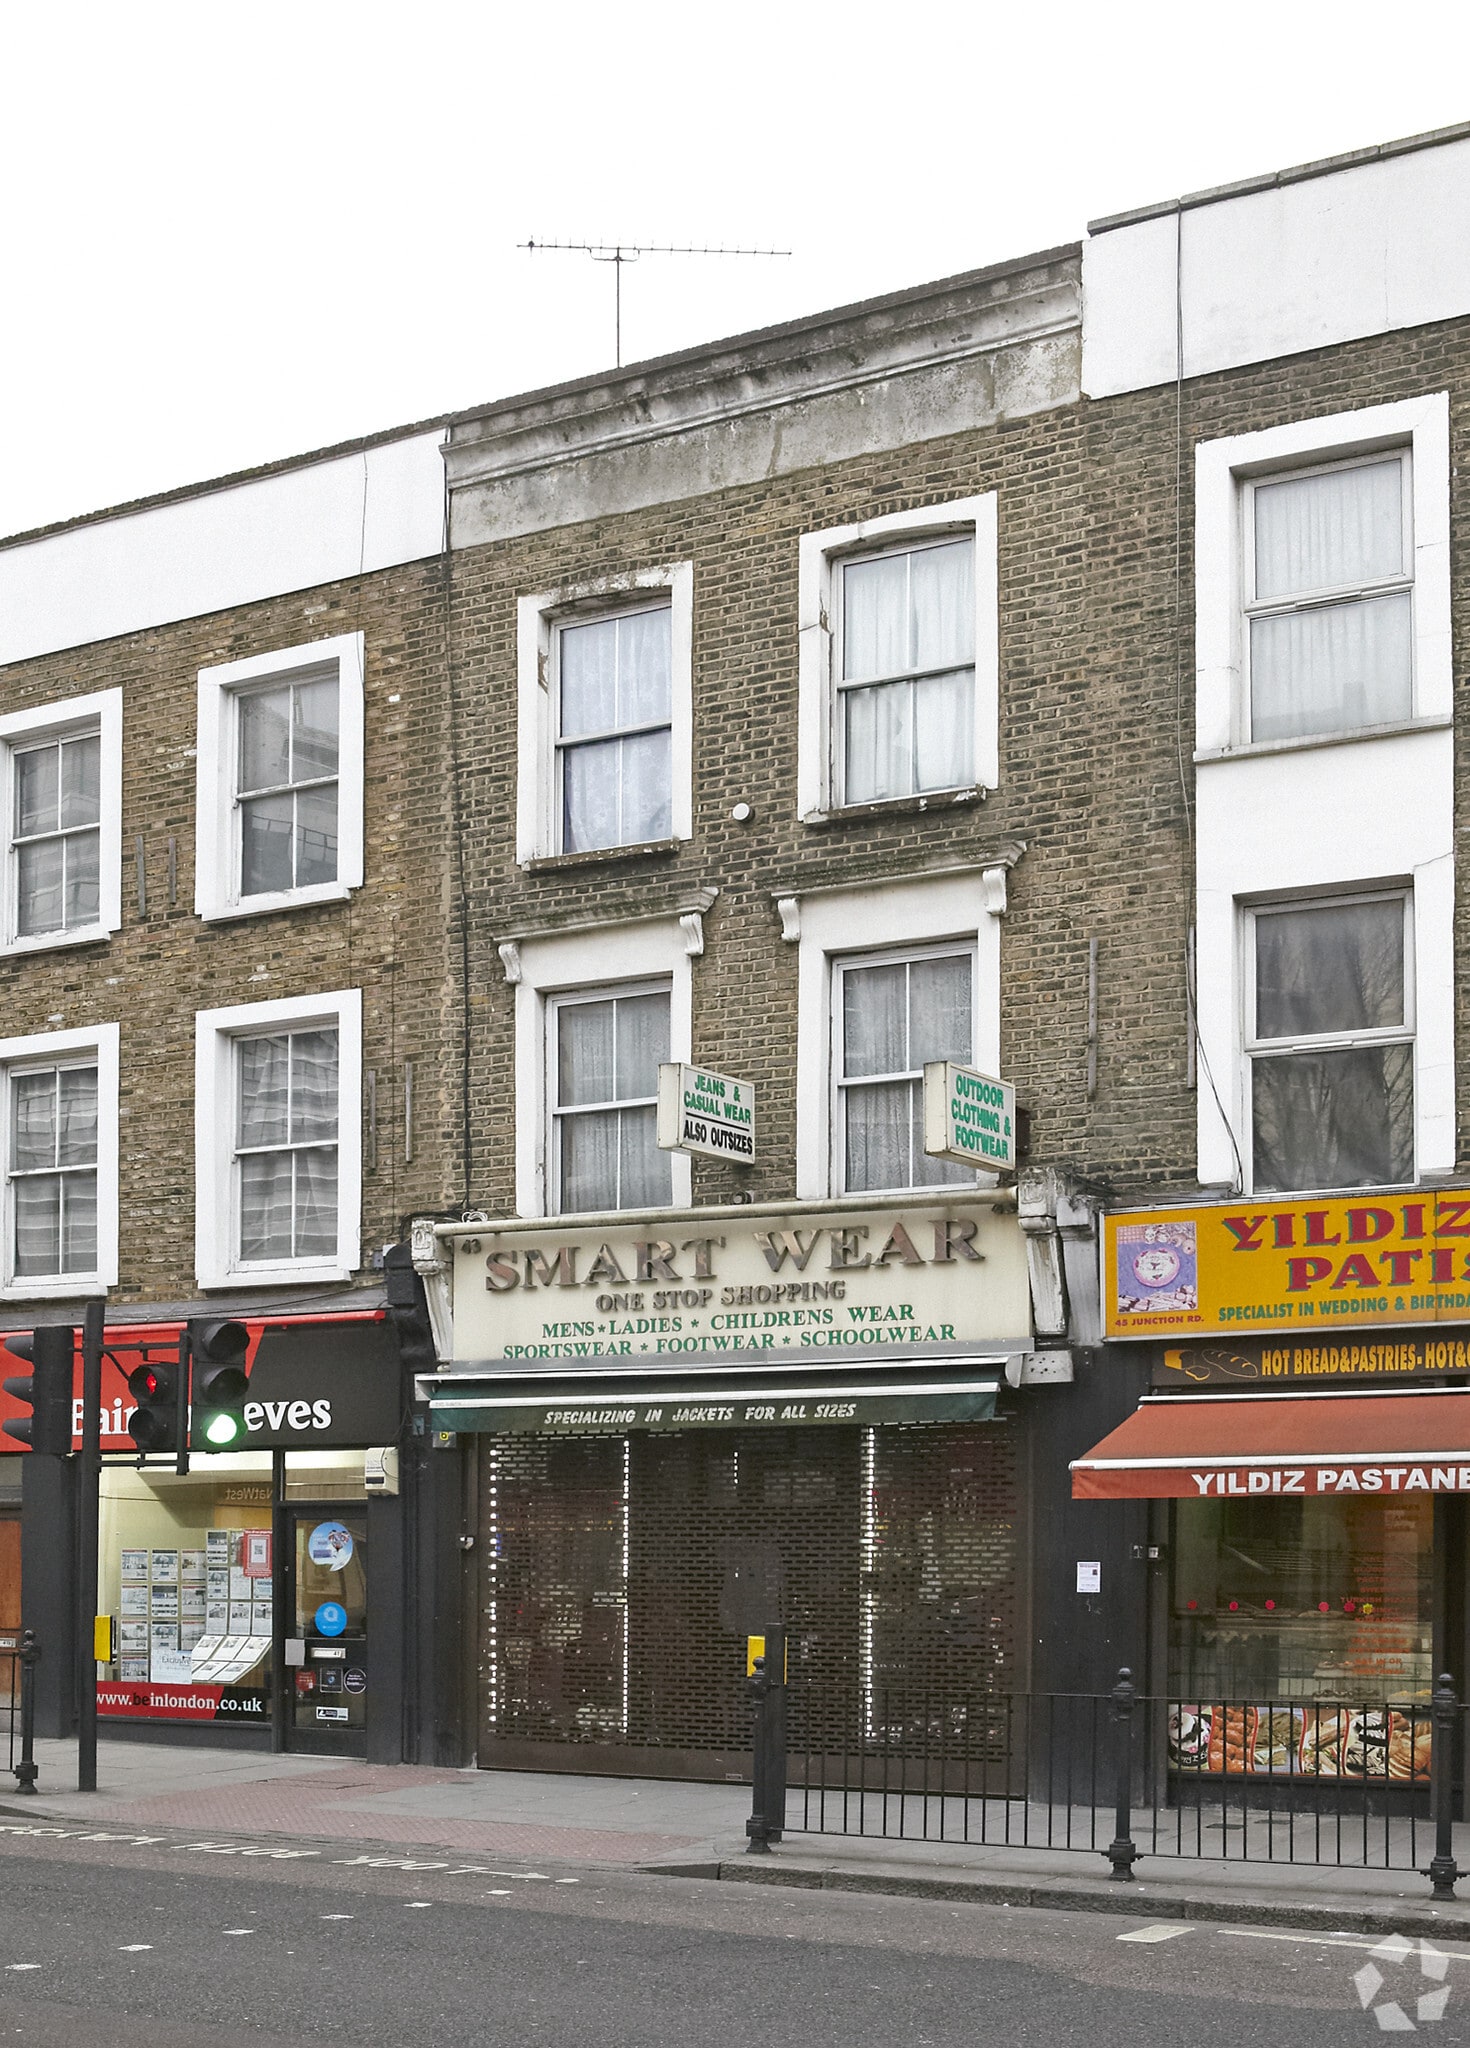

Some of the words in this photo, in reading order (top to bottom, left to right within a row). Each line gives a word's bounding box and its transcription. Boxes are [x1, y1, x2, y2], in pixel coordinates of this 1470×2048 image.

[695, 1075, 726, 1098] JEANS
[733, 1091, 741, 1102] &
[956, 1075, 1004, 1109] OUTDOOR
[683, 1091, 721, 1118] CASUAL
[724, 1102, 752, 1125] WEAR
[951, 1099, 1000, 1130] CLOTHING
[1004, 1123, 1012, 1137] &
[684, 1119, 707, 1144] ALSO
[711, 1126, 753, 1156] OUTSIZES
[955, 1125, 1009, 1161] FOOTWEAR
[1222, 1201, 1470, 1252] YILDIZ
[461, 1238, 482, 1254] 43
[486, 1236, 727, 1292] SMART
[752, 1218, 986, 1272] WEAR
[596, 1292, 645, 1312] ONE
[653, 1288, 714, 1310] STOP
[720, 1280, 846, 1306] SHOPPING
[1218, 1303, 1294, 1322] SPECIALIST
[1299, 1302, 1314, 1317] IN
[1319, 1297, 1389, 1315] WEDDING
[1395, 1296, 1406, 1312] &
[542, 1321, 595, 1339] MENS
[609, 1316, 683, 1336] LADIES
[711, 1308, 834, 1330] CHILDRENS
[847, 1304, 916, 1322] WEAR
[1115, 1319, 1129, 1327] 45
[1131, 1316, 1184, 1327] JUNCTION
[1187, 1315, 1205, 1323] RD.
[503, 1340, 633, 1360] SPORTSWEAR
[656, 1333, 776, 1354] FOOTWEAR
[800, 1324, 957, 1347] SCHOOLWEAR
[1262, 1350, 1290, 1377] HOT
[544, 1408, 636, 1424] SPECIALIZING
[645, 1409, 662, 1422] IN
[672, 1406, 735, 1421] JACKETS
[745, 1406, 775, 1420] FOR
[781, 1405, 807, 1419] ALL
[814, 1403, 857, 1418] SIZES
[1192, 1470, 1306, 1495] YILDIZ
